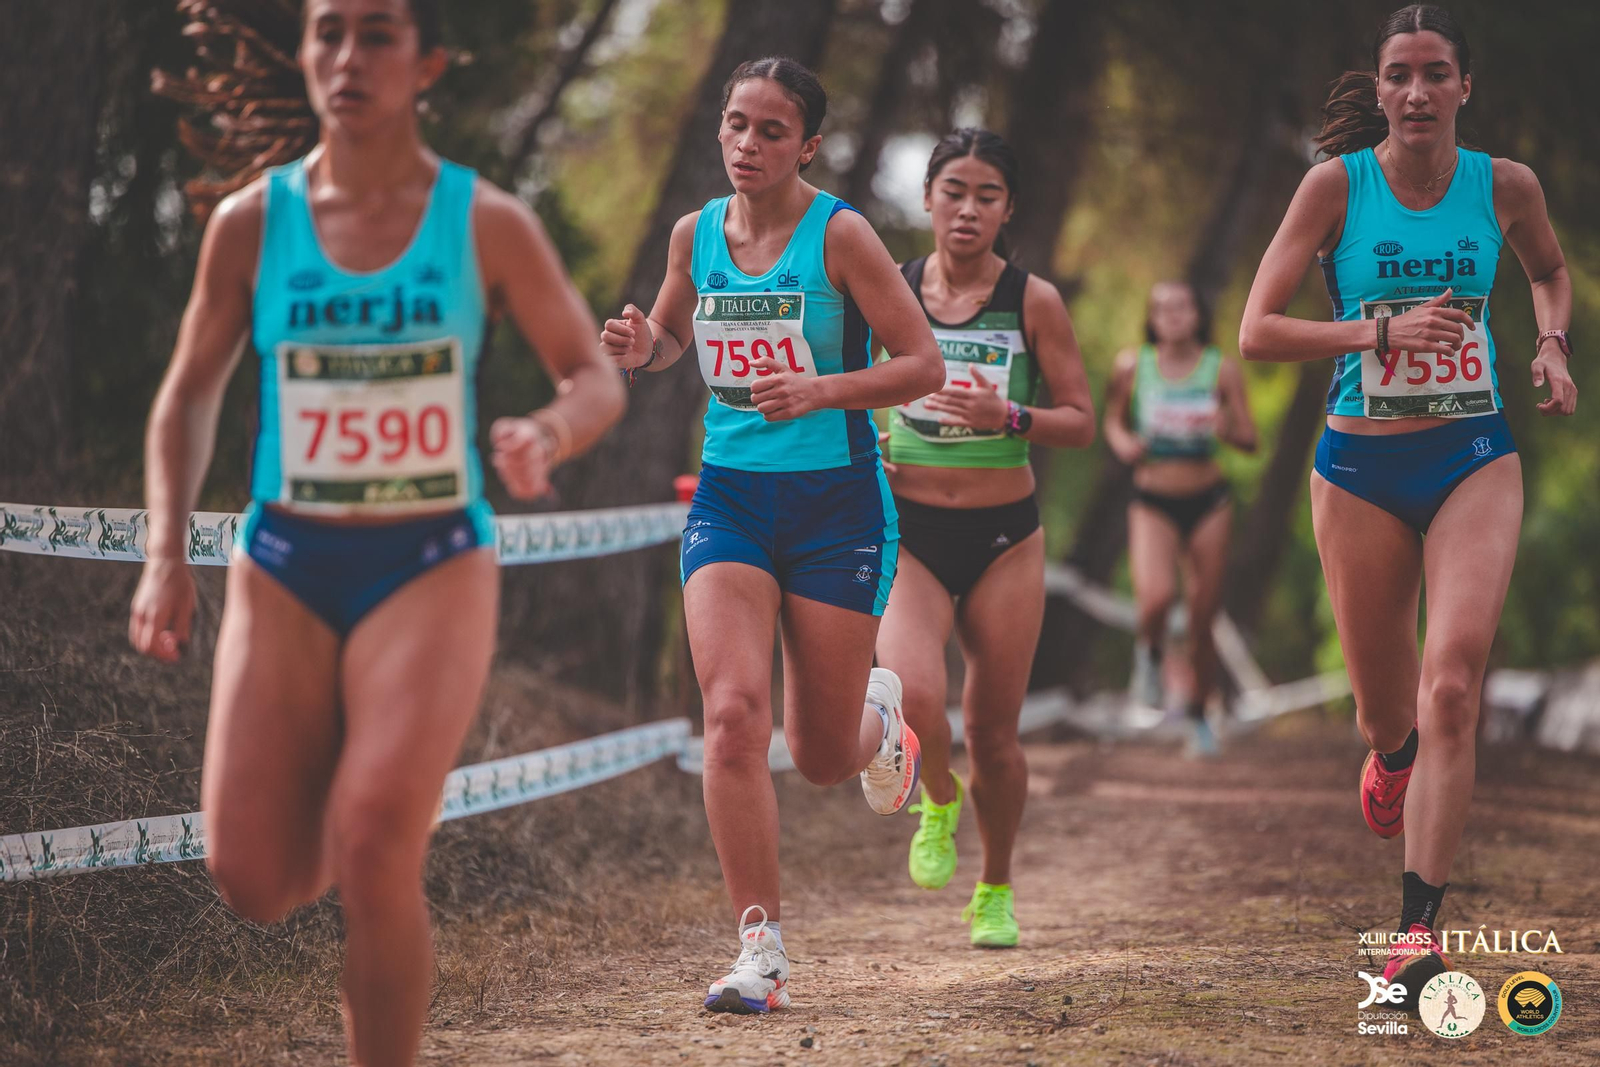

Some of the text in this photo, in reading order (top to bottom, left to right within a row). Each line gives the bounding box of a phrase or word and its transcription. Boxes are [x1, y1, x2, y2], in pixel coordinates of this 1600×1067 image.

[1374, 243, 1403, 256] TROPS
[1457, 236, 1480, 251] als
[776, 268, 800, 287] als
[1376, 251, 1477, 282] nerja
[707, 273, 728, 288] TROPS
[288, 286, 442, 333] nerja
[721, 297, 771, 313] ITÁLICA
[706, 337, 805, 377] 7591
[1380, 342, 1482, 386] 7556
[299, 404, 450, 464] 7590
